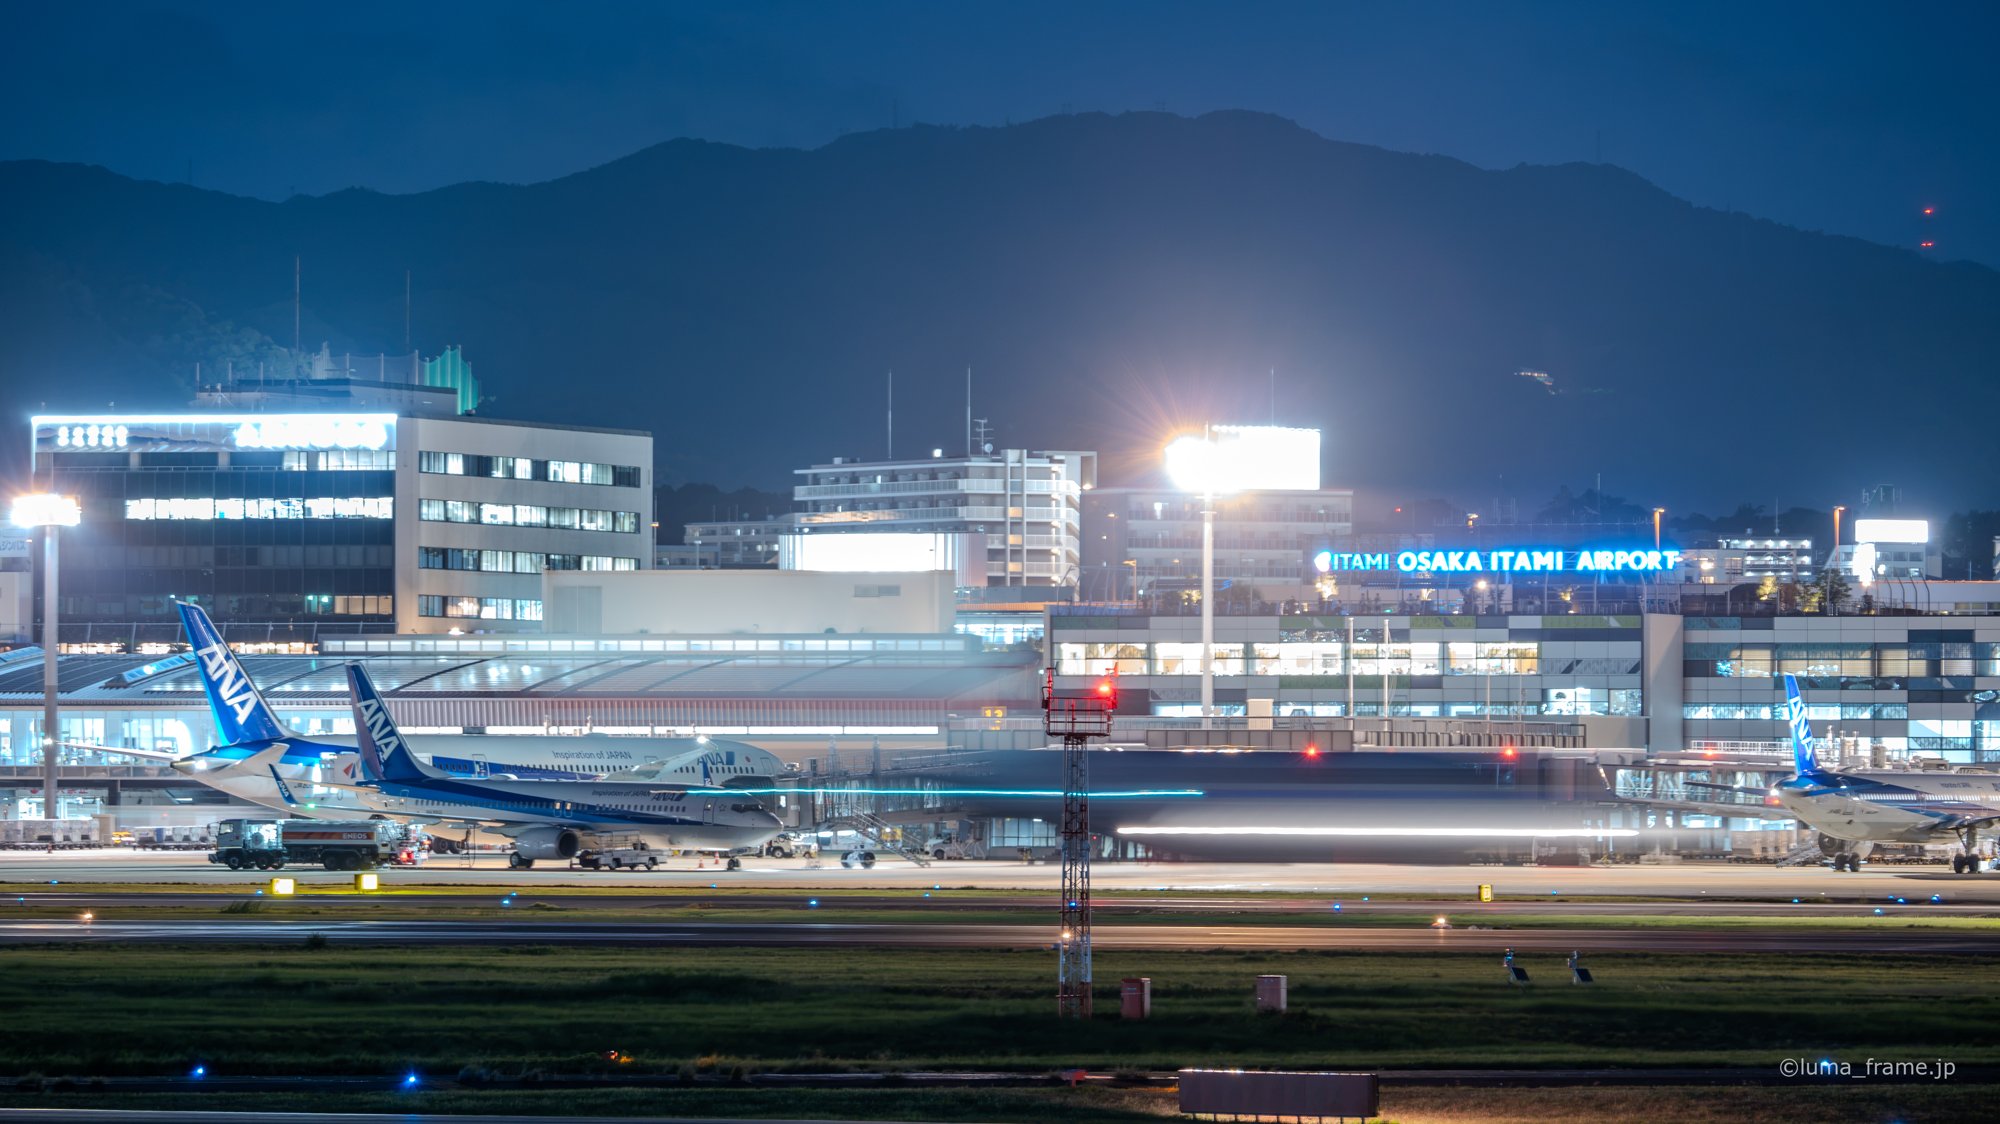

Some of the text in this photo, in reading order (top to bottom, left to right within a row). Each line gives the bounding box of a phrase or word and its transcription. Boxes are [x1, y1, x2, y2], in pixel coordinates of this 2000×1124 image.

[1332, 550, 1679, 573] ITAMI OSAKA ITAMI AIRPORT
[197, 643, 260, 725] ANA
[356, 698, 401, 761] ANA
[552, 750, 633, 760] Inspiration of JAPAN
[277, 780, 290, 797] ANA
[342, 832, 368, 840] ENEOS
